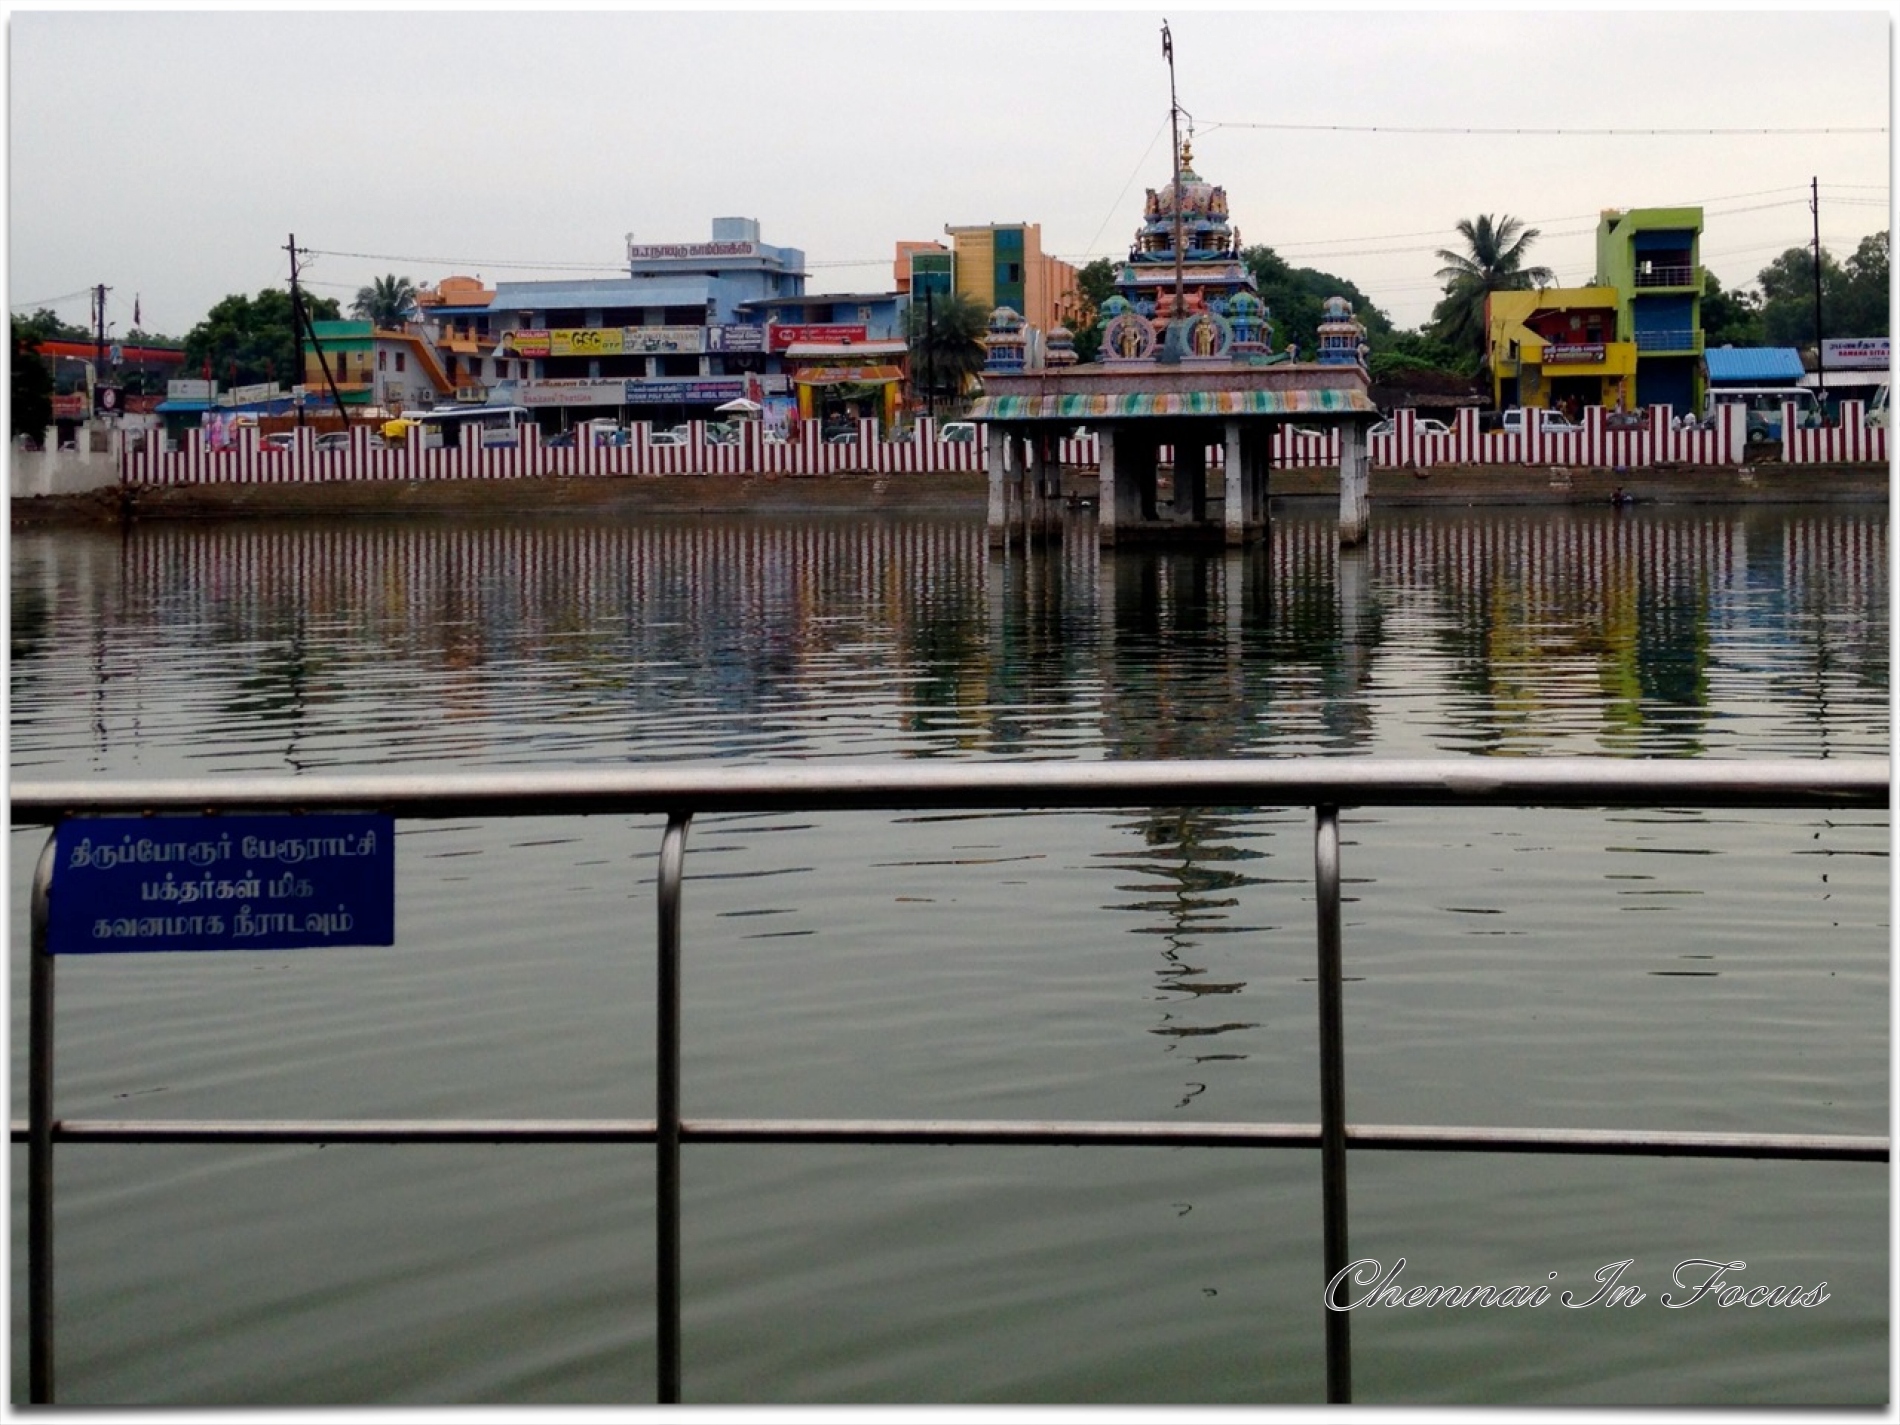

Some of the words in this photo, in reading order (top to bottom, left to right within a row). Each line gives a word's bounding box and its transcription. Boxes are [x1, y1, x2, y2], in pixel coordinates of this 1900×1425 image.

[572, 331, 600, 347] CSC
[68, 832, 232, 870] திருப்போரூர்
[242, 829, 377, 864] பேரூராட்சி
[141, 869, 261, 904] பக்தர்கள்
[268, 871, 314, 899] மிக
[92, 914, 225, 939] கவனமாக
[232, 904, 353, 939] நீராடவும்
